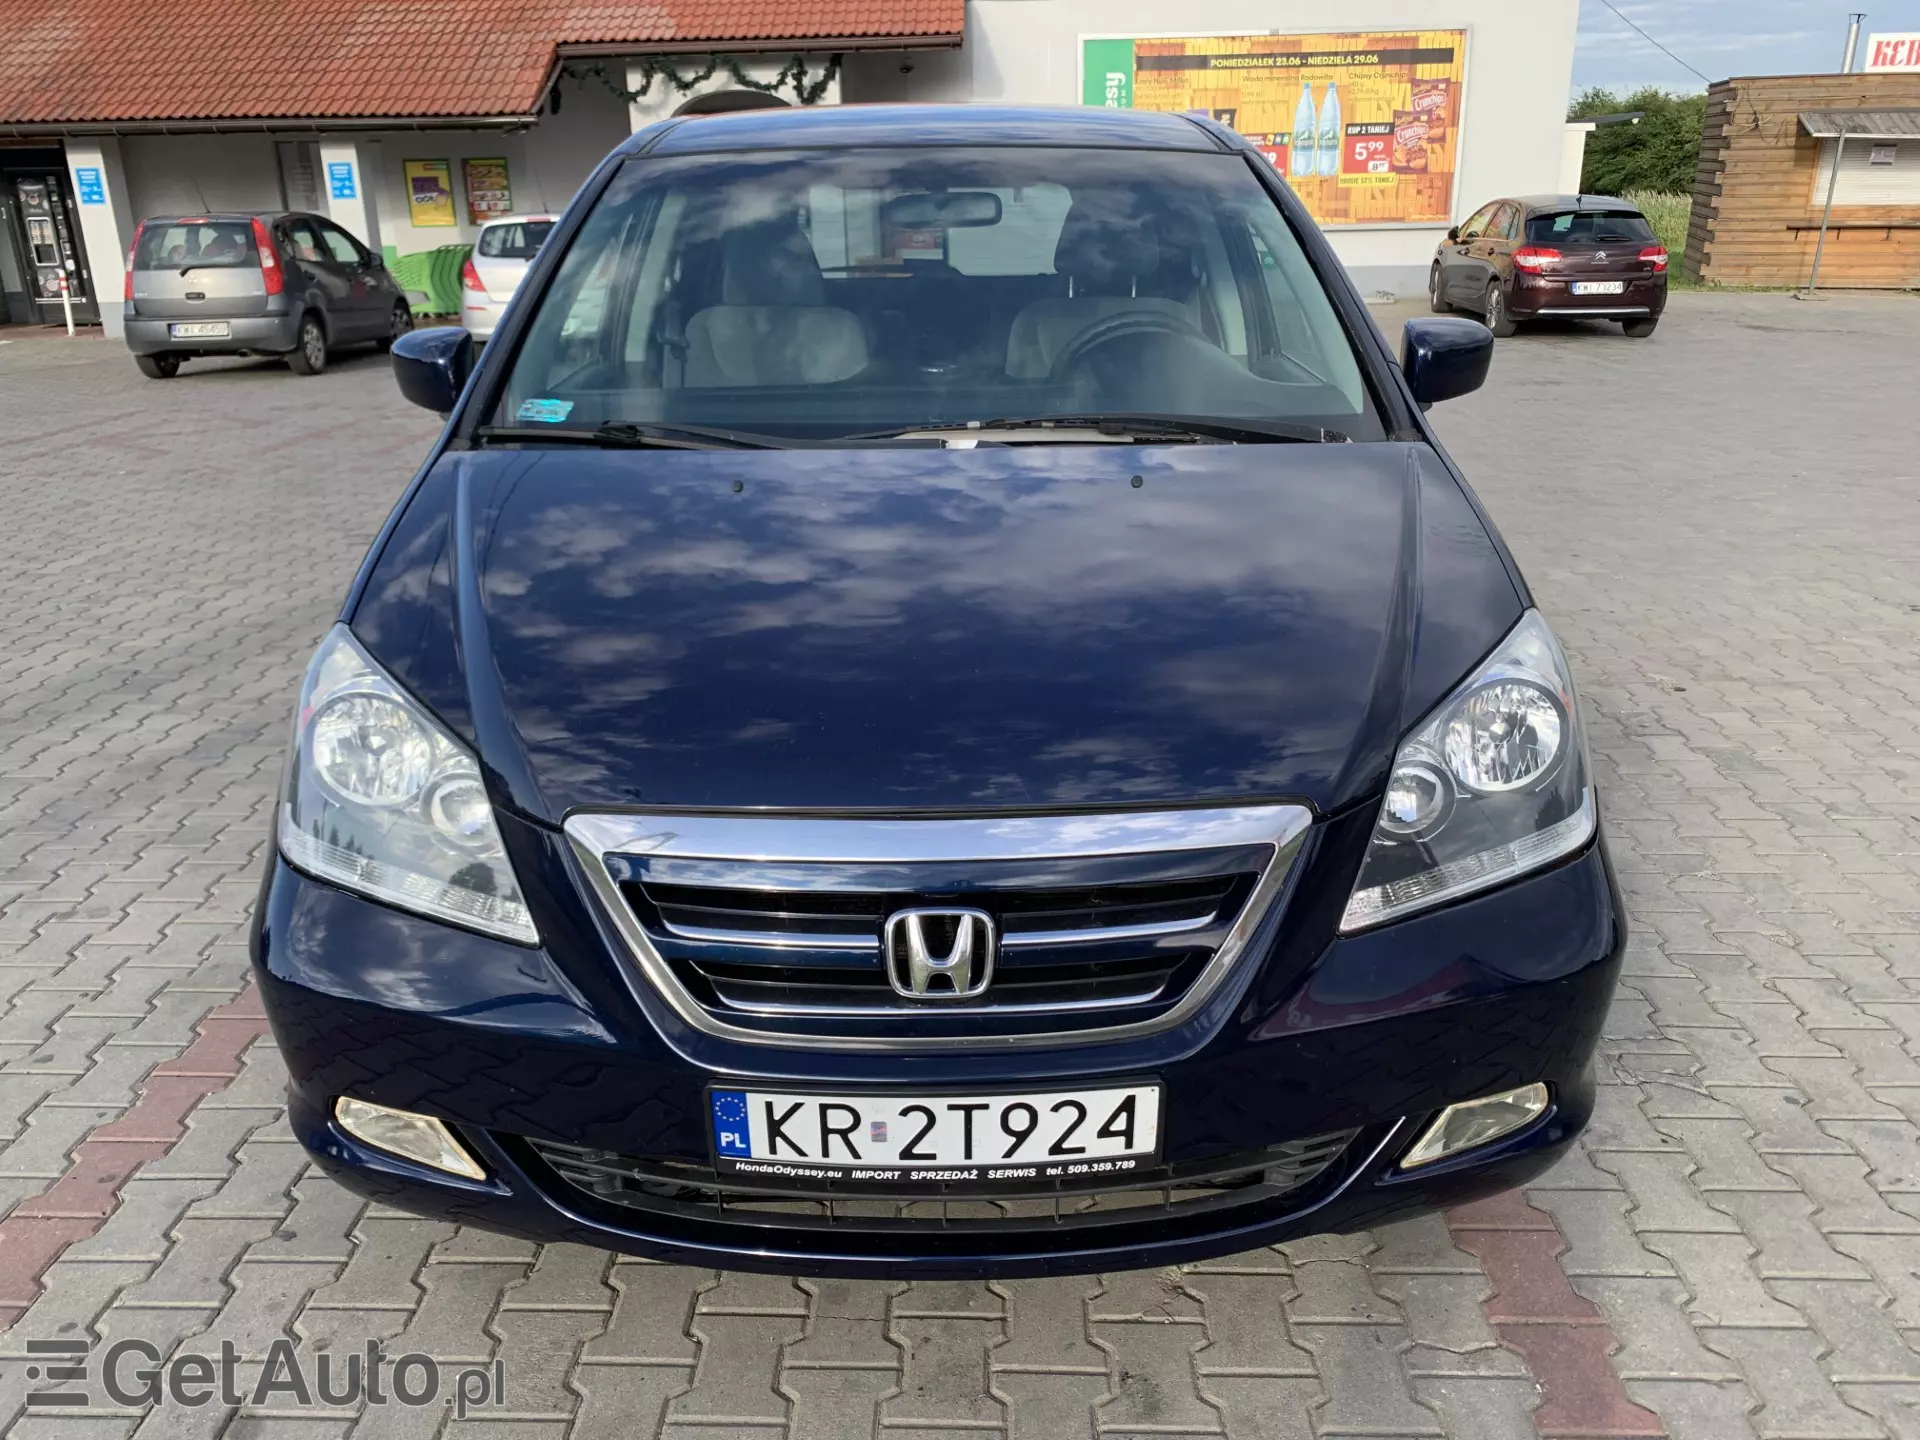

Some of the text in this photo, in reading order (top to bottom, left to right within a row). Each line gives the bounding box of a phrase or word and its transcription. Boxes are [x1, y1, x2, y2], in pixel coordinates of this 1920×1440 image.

[1210, 58, 1274, 68] PONIEDZIAŁEK
[1276, 57, 1300, 66] 23.06
[1308, 56, 1352, 65] NIEDZIELA
[1354, 54, 1379, 64] 29.06
[1347, 126, 1361, 135] KUP
[1367, 125, 1390, 133] TANIEJ
[764, 1094, 1137, 1161] KR 2T924
[719, 1131, 748, 1149] PL
[735, 1159, 1137, 1181] HondaOdyssey.eu IMPORT SPRZEDAŻ SERWIS tel. 509.359.789
